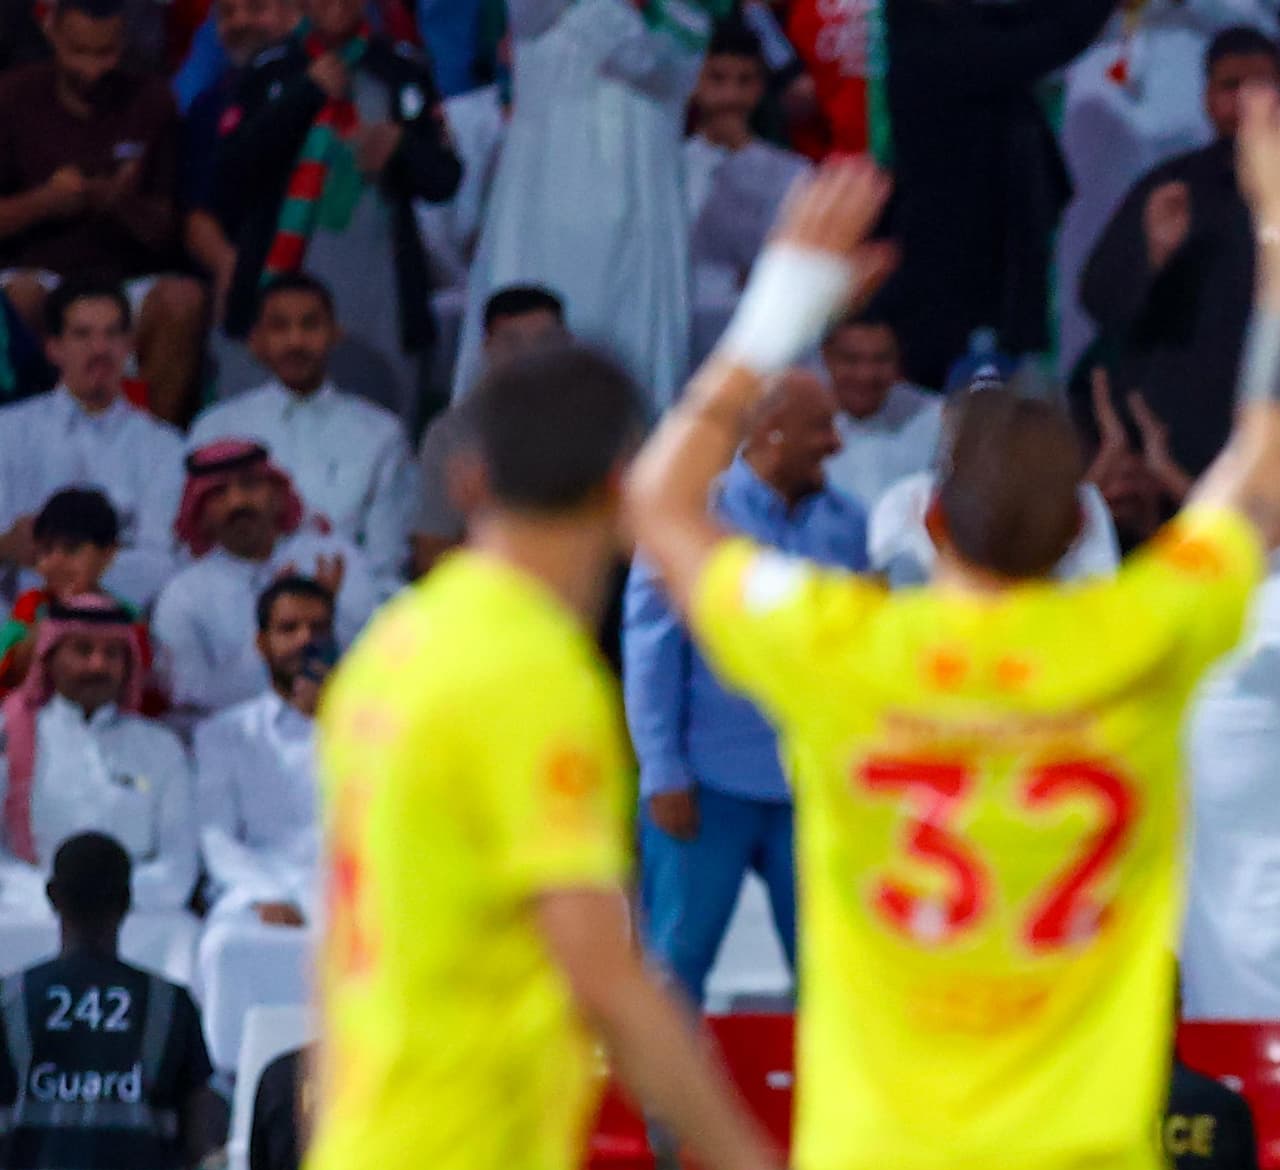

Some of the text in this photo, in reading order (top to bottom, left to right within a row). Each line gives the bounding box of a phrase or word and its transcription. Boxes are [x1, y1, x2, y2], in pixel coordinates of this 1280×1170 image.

[852, 752, 1139, 954] 32
[45, 984, 133, 1032] 242
[30, 1061, 142, 1102] Guard
